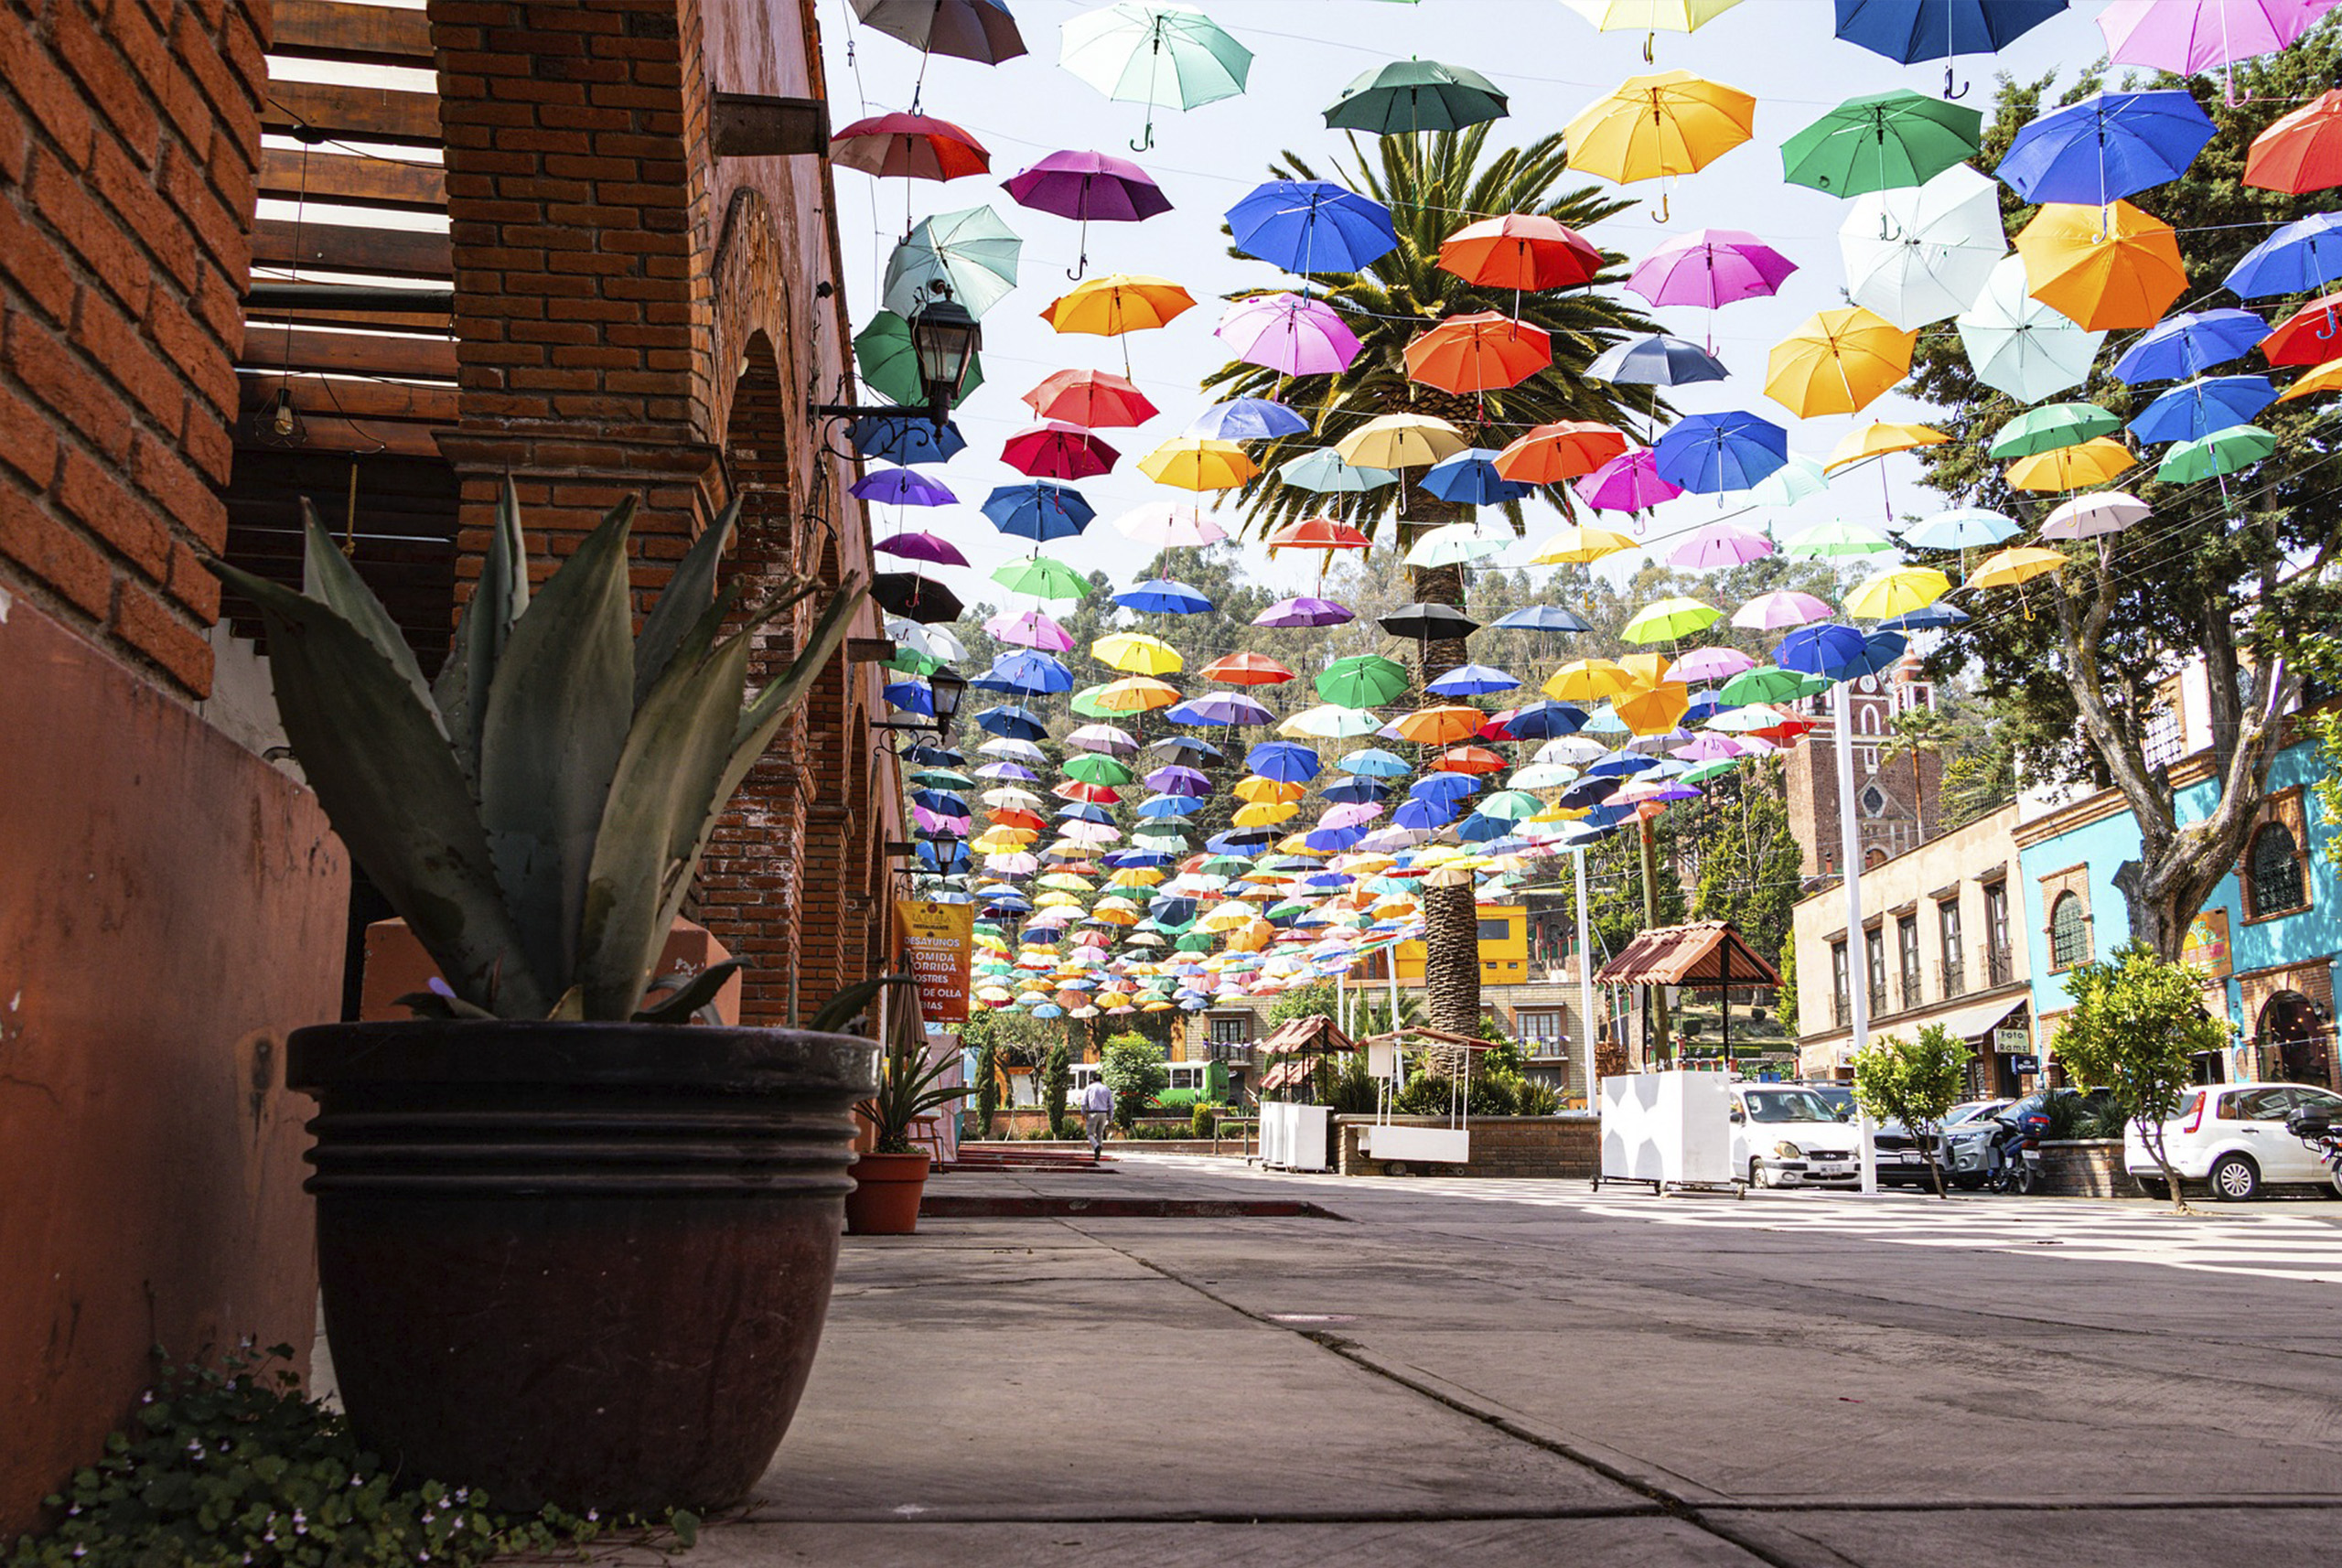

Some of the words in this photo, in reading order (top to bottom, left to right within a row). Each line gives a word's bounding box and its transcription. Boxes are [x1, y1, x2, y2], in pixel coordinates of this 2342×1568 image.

[924, 914, 951, 922] PERLA
[904, 937, 960, 948] DESAYUNOS
[914, 961, 957, 972] ORRIDA
[915, 973, 949, 983] OSTRES
[923, 988, 935, 997] DE
[937, 988, 962, 998] OLLA
[920, 1001, 943, 1011] ENAS
[2001, 1030, 2024, 1039] Foto
[1999, 1043, 2027, 1052] Ramz
